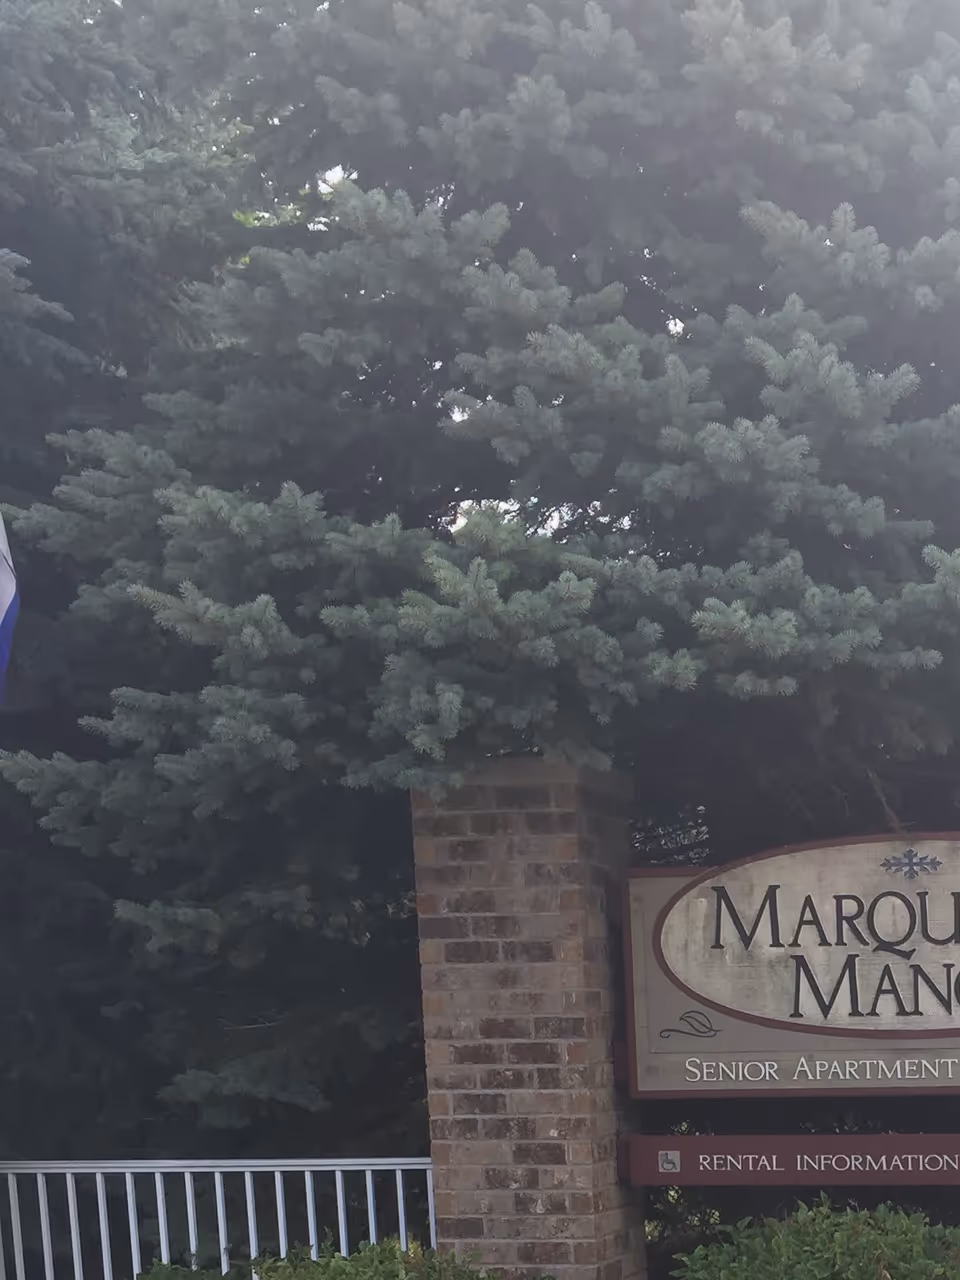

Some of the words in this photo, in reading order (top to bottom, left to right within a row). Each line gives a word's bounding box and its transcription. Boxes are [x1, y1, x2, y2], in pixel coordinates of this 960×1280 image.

[684, 1057, 780, 1082] SENIOR
[792, 1056, 958, 1081] APARTMENT
[699, 1154, 785, 1171] RENTAL
[796, 1154, 960, 1171] INFORMATION
